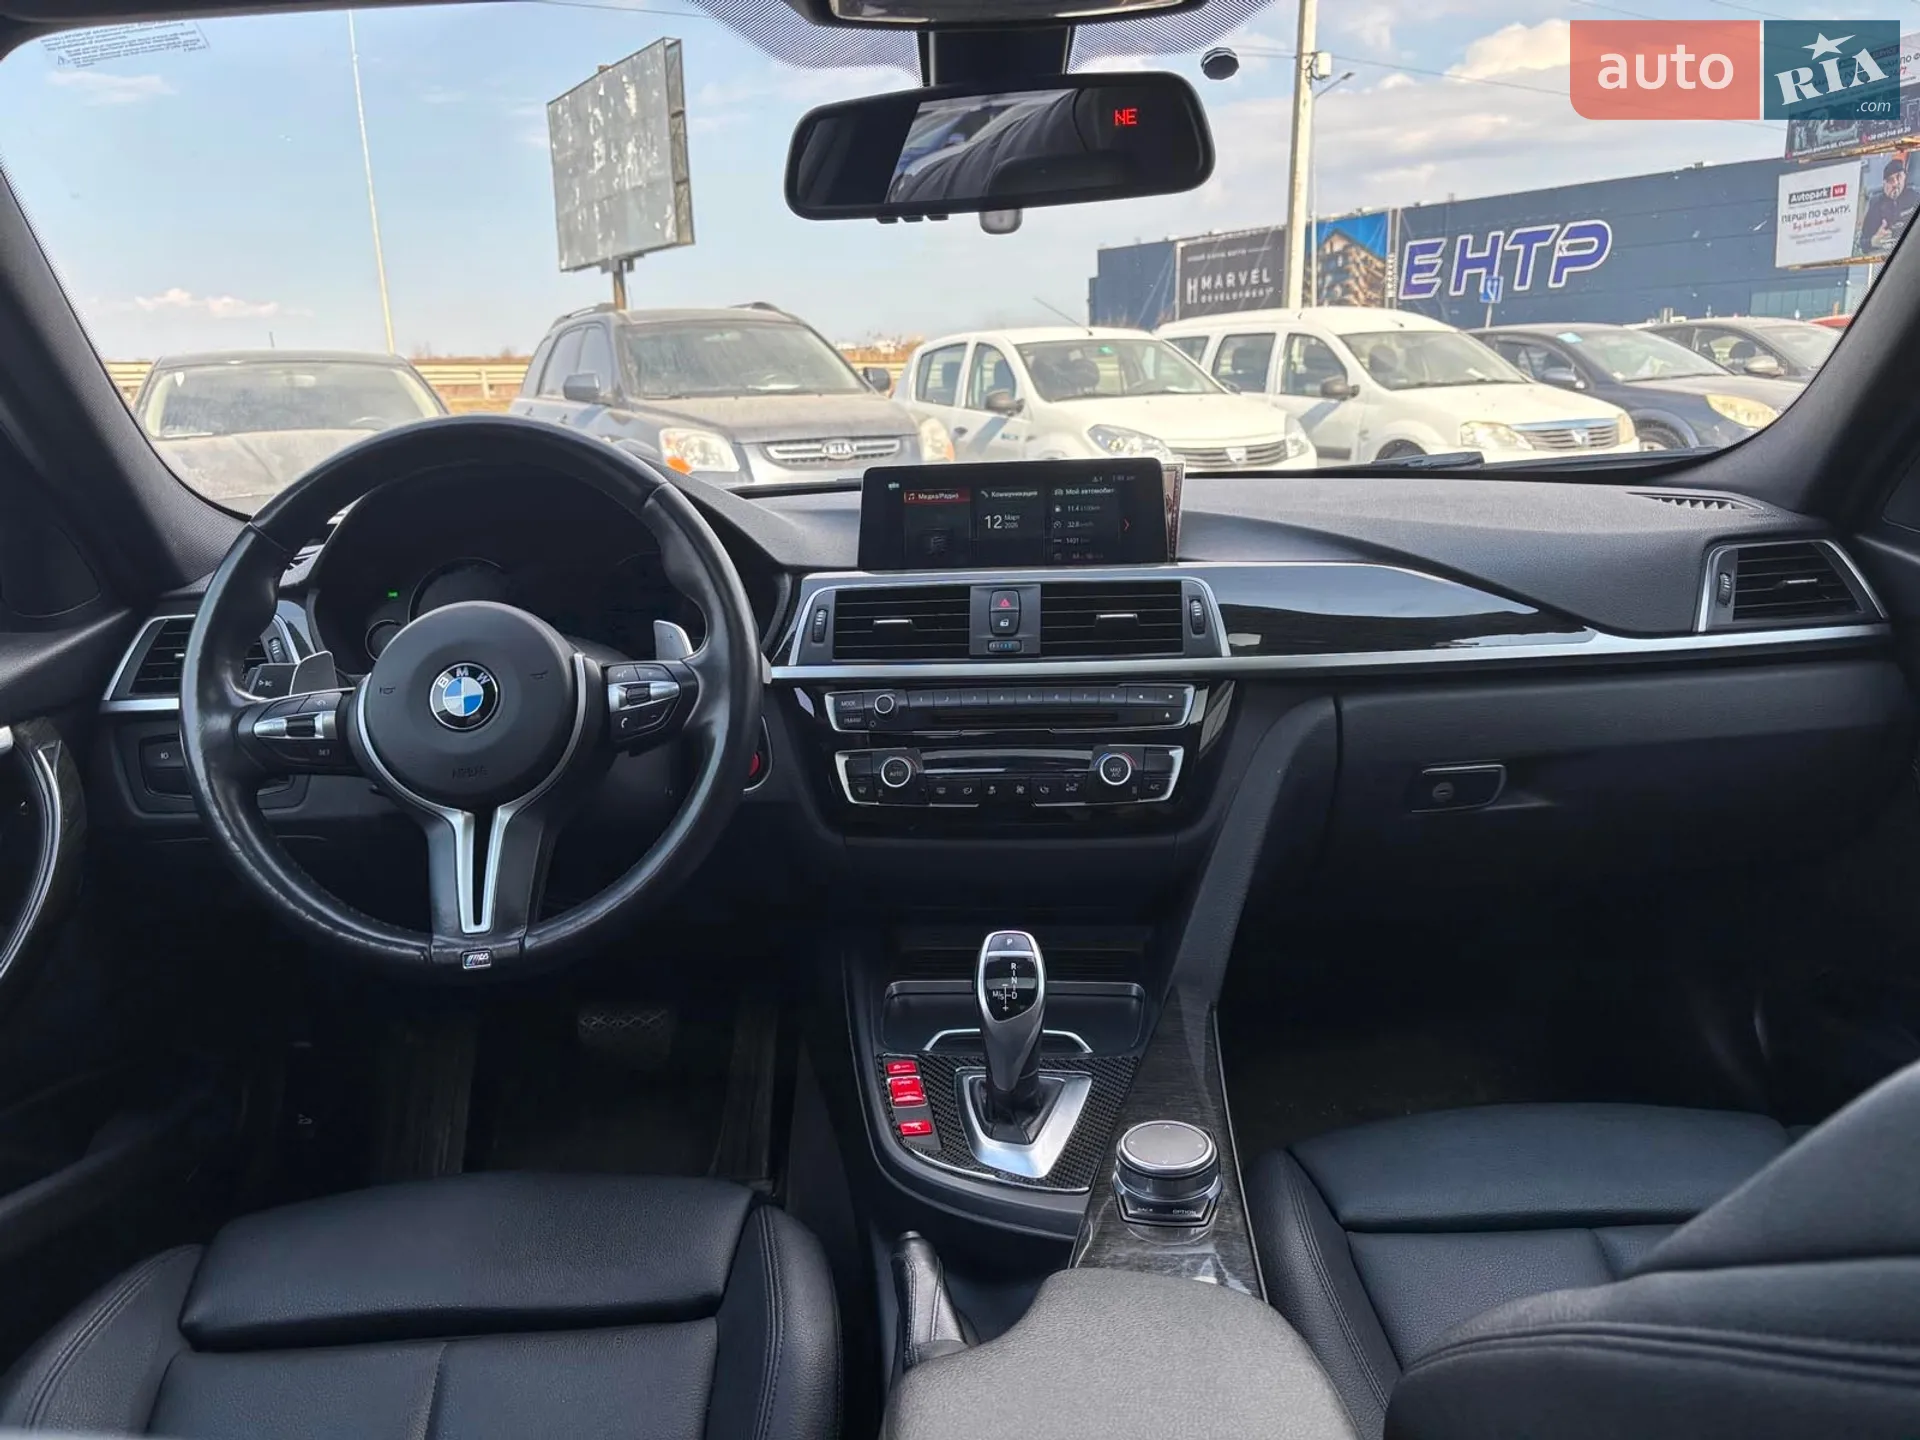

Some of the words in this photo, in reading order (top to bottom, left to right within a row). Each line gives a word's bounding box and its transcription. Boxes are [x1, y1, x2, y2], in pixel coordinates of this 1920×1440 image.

[1114, 108, 1138, 126] NE
[1790, 189, 1828, 202] Autopark
[1808, 210, 1820, 219] ПО
[1201, 267, 1272, 290] MARVEL
[984, 514, 1003, 529] 12
[437, 667, 491, 688] BMW
[1006, 938, 1013, 946] P
[1010, 962, 1017, 970] R
[1011, 976, 1018, 984] N
[1011, 991, 1018, 1000] D
